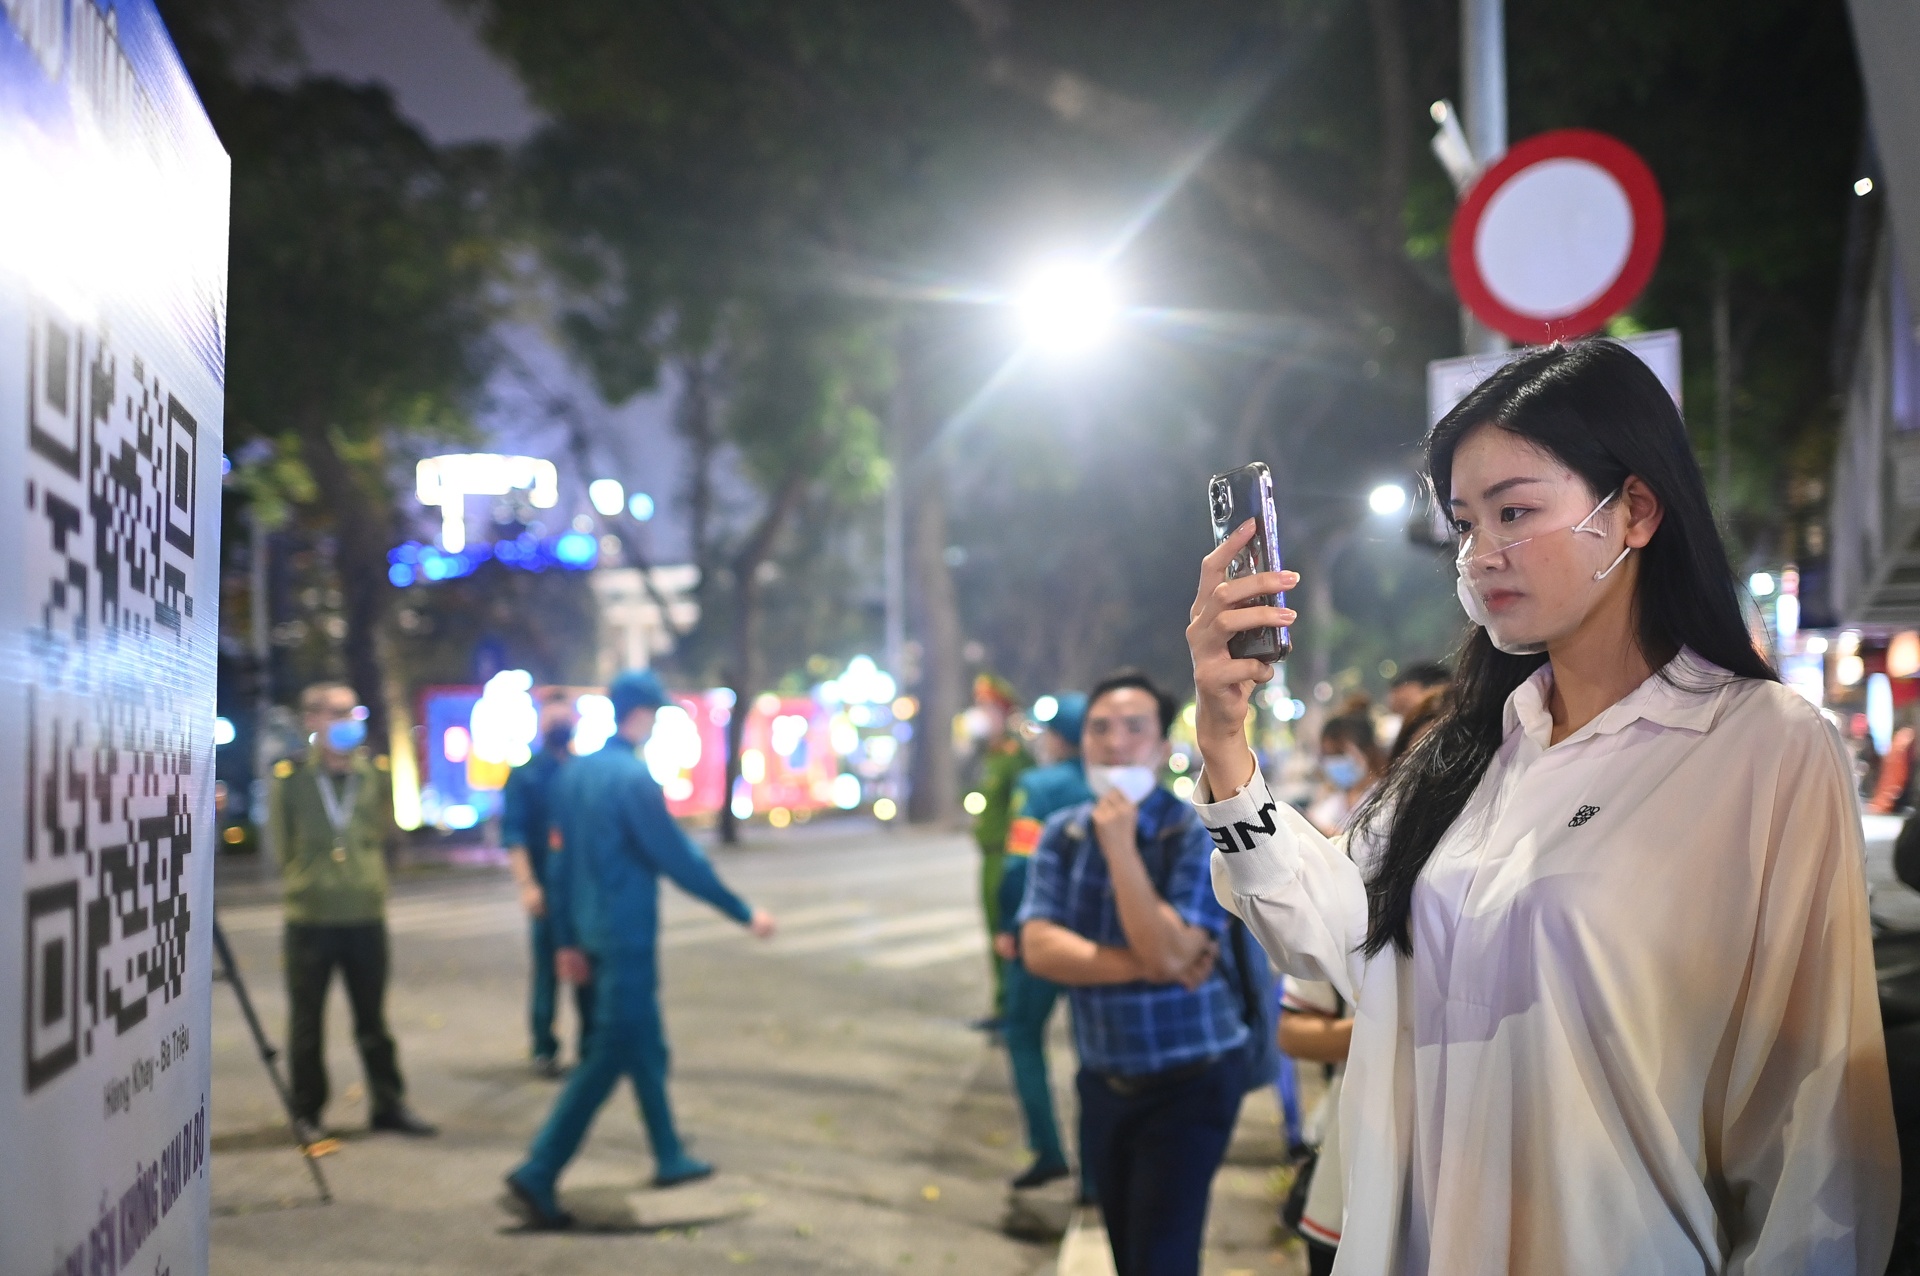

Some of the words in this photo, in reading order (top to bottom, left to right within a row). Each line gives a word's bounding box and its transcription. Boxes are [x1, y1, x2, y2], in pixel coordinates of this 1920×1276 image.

[161, 1035, 171, 1073] Bà
[172, 1023, 190, 1062] Triệu
[161, 1130, 182, 1219] GIAN
[193, 1092, 205, 1181] BỘ
